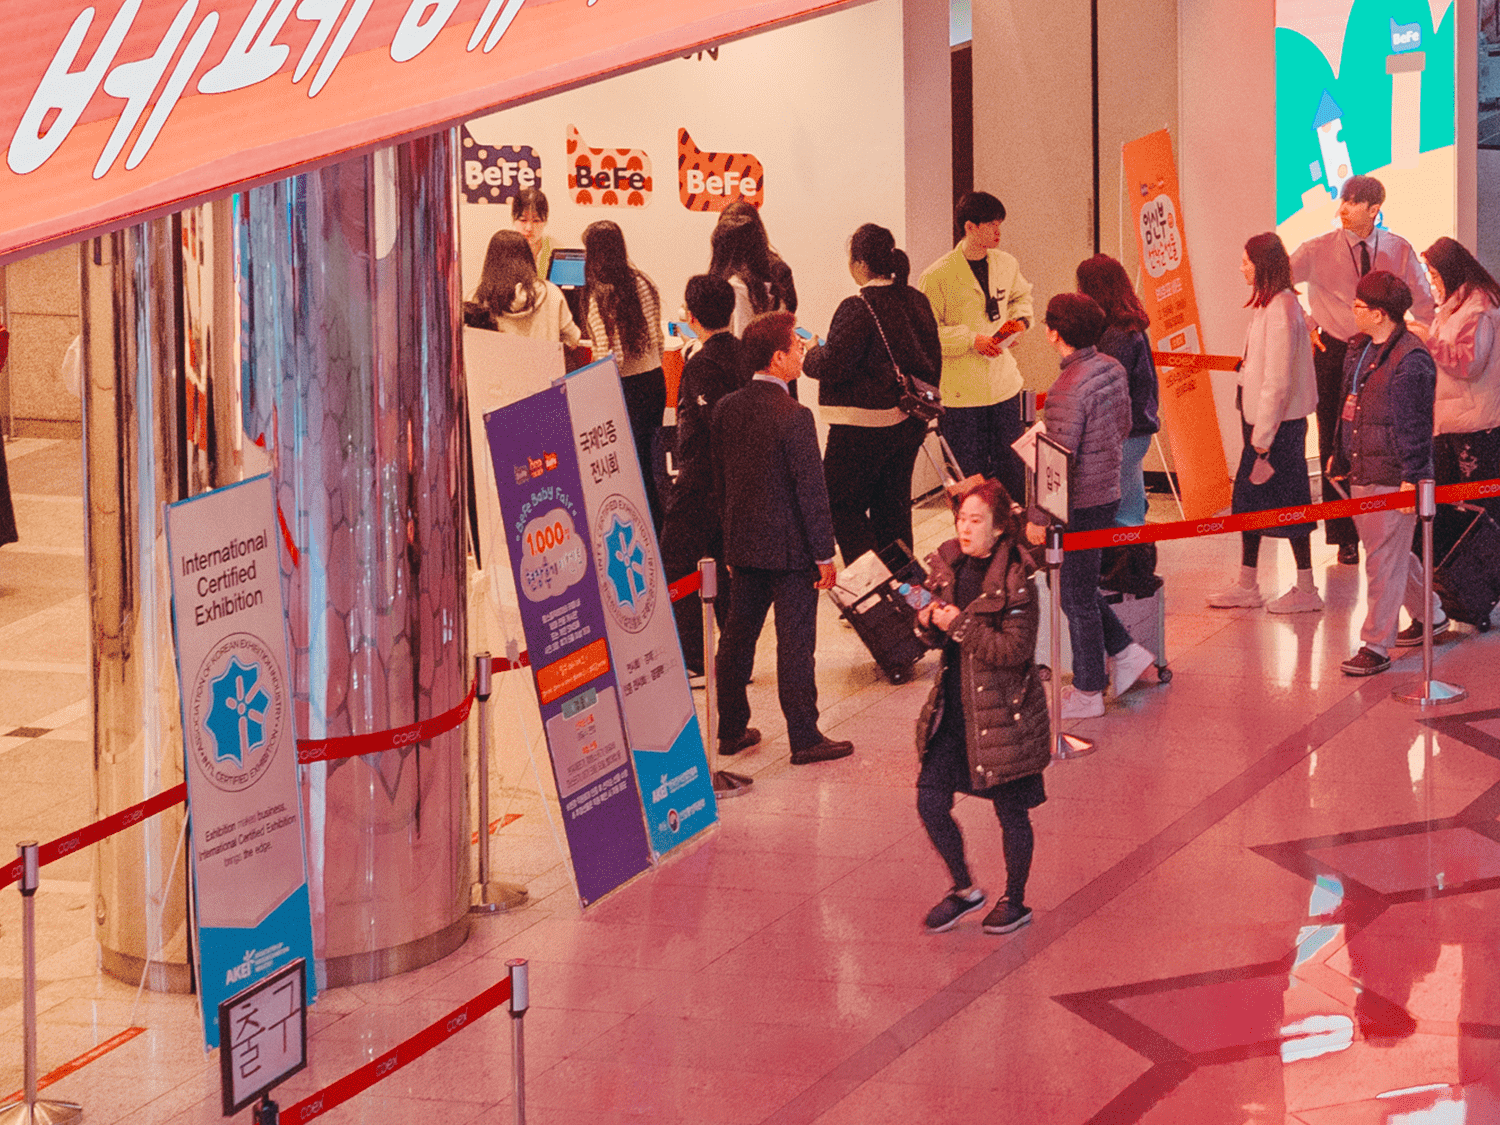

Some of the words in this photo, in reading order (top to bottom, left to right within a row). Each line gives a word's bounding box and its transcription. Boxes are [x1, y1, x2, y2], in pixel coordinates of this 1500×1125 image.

[1392, 29, 1420, 46] BeFe
[464, 160, 535, 187] BeFe
[575, 165, 645, 191] BeFe
[686, 168, 757, 197] BeFe
[579, 419, 618, 455] 국제인증
[589, 451, 620, 485] 전시회
[530, 485, 554, 507] Baby
[555, 486, 574, 510] Fair
[1359, 496, 1388, 511] coex
[1196, 517, 1225, 534] coex
[1278, 508, 1307, 524] coex
[1112, 528, 1142, 545] coex
[181, 529, 268, 576] International
[197, 560, 257, 597] Certified
[194, 588, 264, 627] Exhibition
[211, 638, 239, 666] KOREAN
[393, 724, 422, 746] coex
[197, 838, 237, 862] International
[266, 814, 297, 834] Exhibition
[204, 822, 237, 843] Exhibition
[231, 980, 301, 1079] 출구
